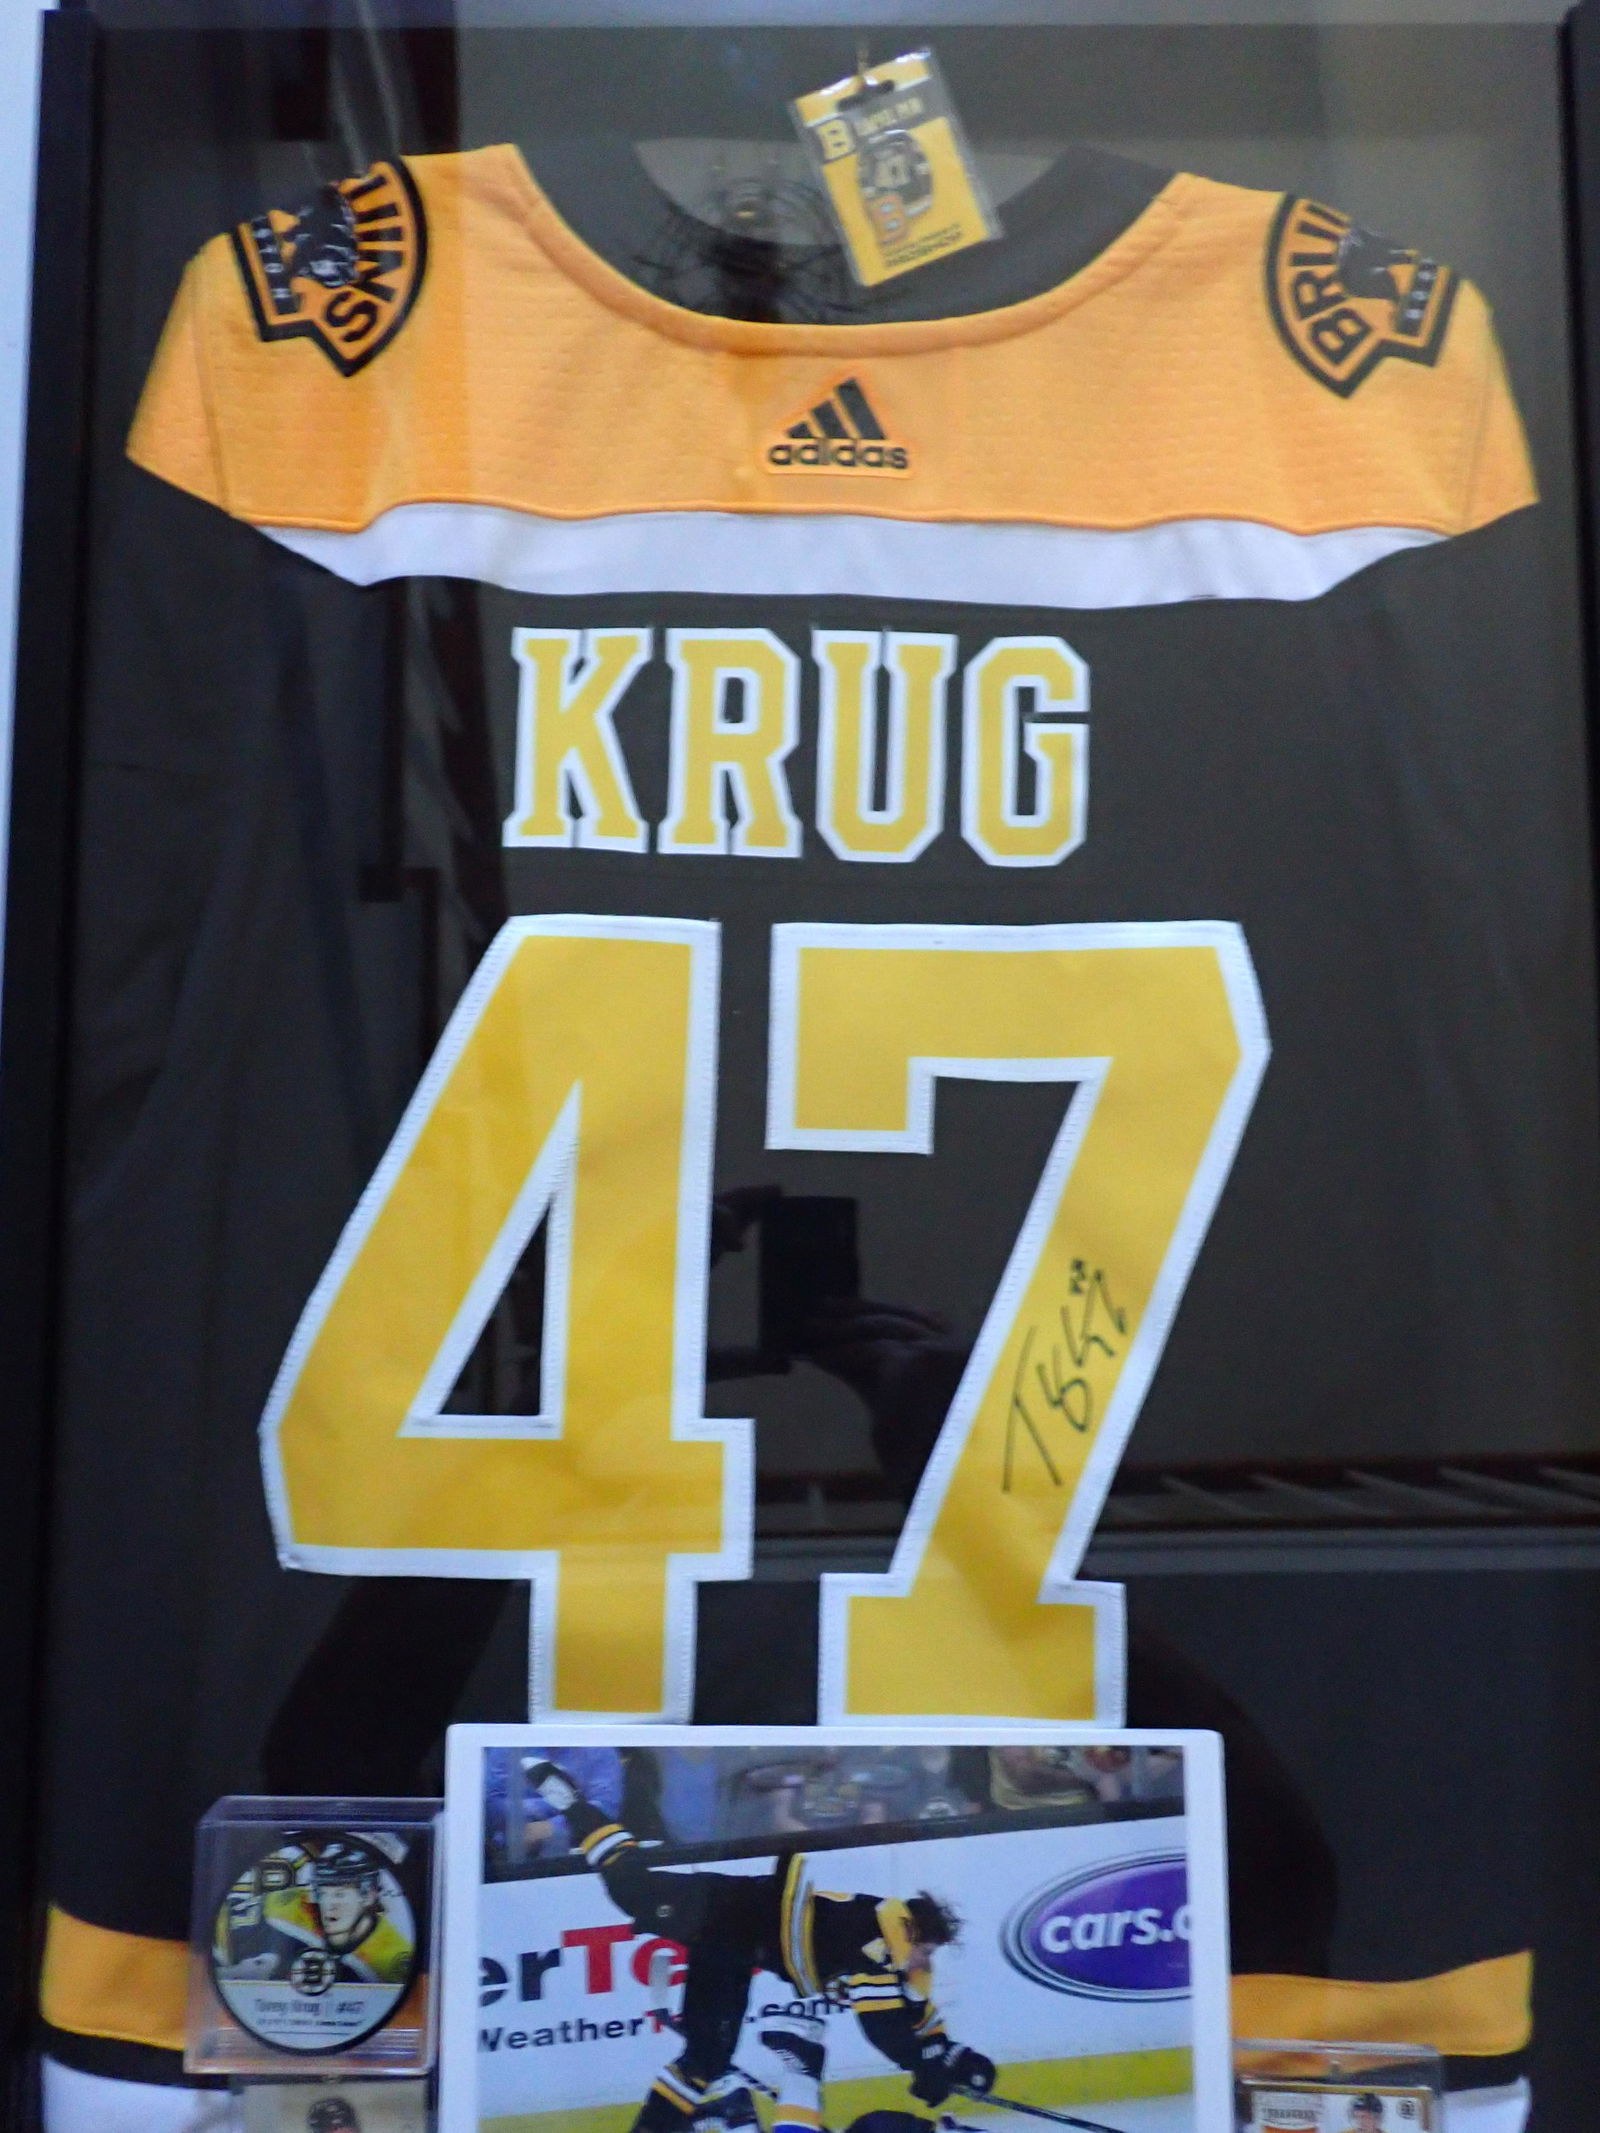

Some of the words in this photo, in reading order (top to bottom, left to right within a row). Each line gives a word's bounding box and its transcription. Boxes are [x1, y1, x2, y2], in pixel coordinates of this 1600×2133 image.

[769, 441, 909, 470] adidas
[503, 626, 1091, 868] KRUG
[259, 914, 1272, 1728] 47
